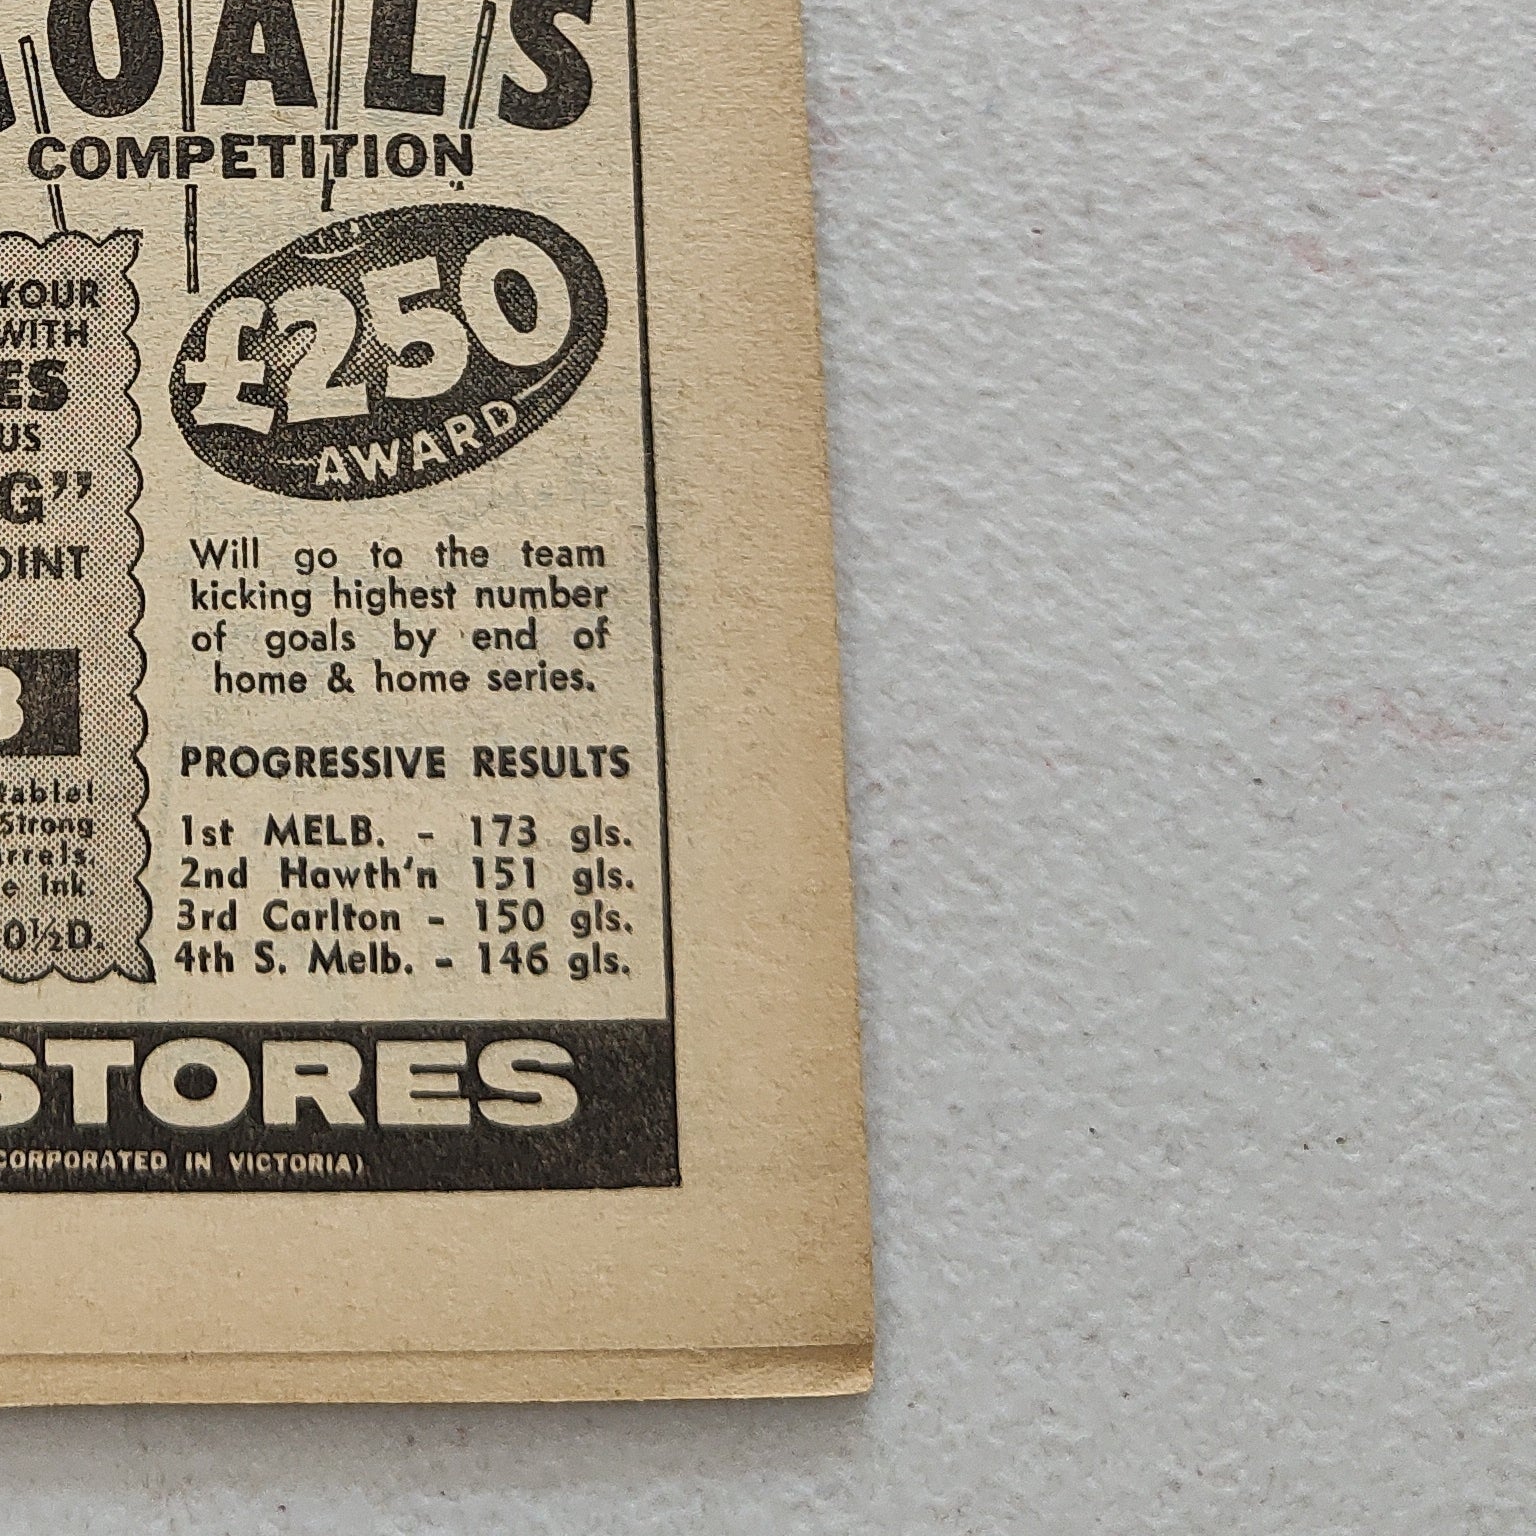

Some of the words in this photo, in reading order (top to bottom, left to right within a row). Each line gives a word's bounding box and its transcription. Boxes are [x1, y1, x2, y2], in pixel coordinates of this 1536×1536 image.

[28, 133, 474, 180] COMPETITION
[185, 235, 571, 434] £250
[315, 400, 518, 486] AWARD
[188, 535, 259, 572] Will
[294, 547, 338, 578] go
[369, 541, 403, 573] to
[434, 533, 490, 570] the
[520, 539, 607, 569] team
[189, 576, 312, 618] kicking
[332, 574, 458, 617] highest
[475, 573, 611, 613] number
[190, 618, 228, 654] of
[264, 616, 357, 660] goals
[393, 617, 438, 659] by
[471, 615, 539, 653] end
[573, 614, 612, 652] of
[214, 658, 308, 699] home
[326, 660, 356, 695] &
[371, 657, 471, 694] home
[487, 659, 597, 693] series.
[180, 740, 446, 782] PROGRESSIVE
[472, 744, 631, 781] RESULTS
[0, 812, 94, 838] Strong
[181, 814, 235, 848] 1st
[263, 812, 385, 850] MELB.
[470, 813, 538, 850] 173
[570, 813, 633, 856] gls.
[180, 855, 248, 891] 2nd
[279, 855, 439, 893] Hawth'n
[471, 855, 536, 892] 151
[572, 856, 635, 897] gls.
[176, 898, 237, 934] 3rd
[262, 896, 402, 934] Carlton
[474, 898, 545, 936] 150
[570, 898, 634, 940] gls.
[173, 939, 235, 977] 4th
[254, 939, 287, 976] S.
[307, 937, 414, 977] Melb.
[477, 940, 549, 978] 146
[567, 940, 631, 982] gls.
[186, 1151, 211, 1171] IN
[228, 1151, 364, 1175] VICTORIA)
